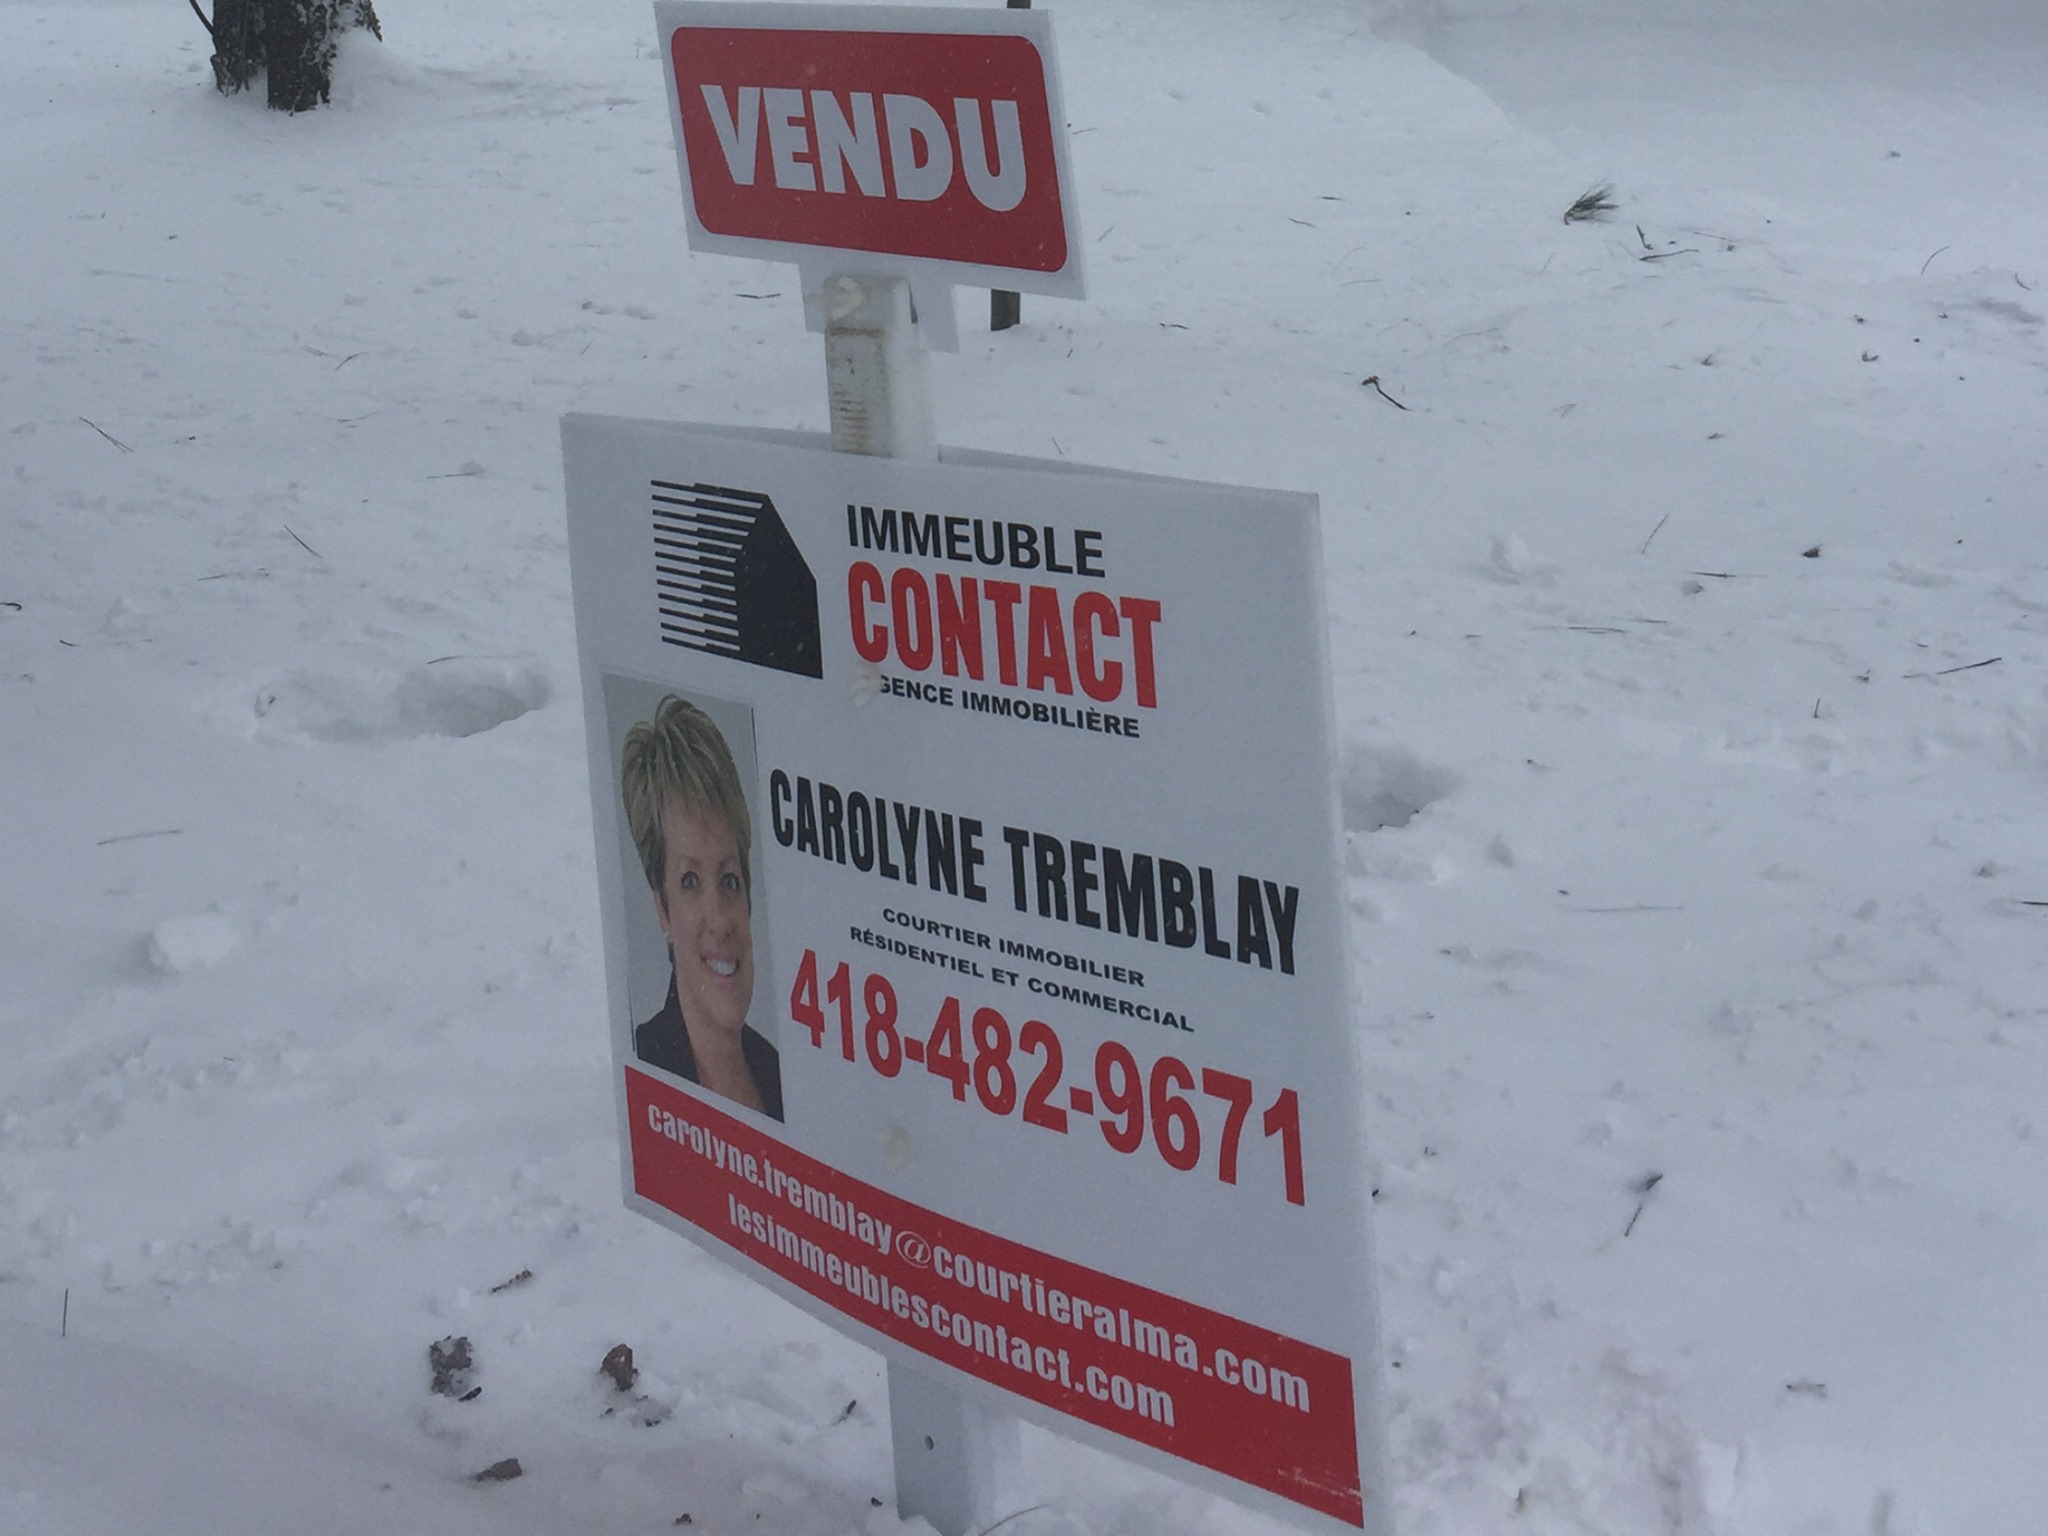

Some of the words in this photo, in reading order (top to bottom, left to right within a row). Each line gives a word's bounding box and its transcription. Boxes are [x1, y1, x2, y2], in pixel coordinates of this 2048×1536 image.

[700, 84, 1027, 212] VENDU
[847, 504, 1106, 578] IMMEUBLE
[848, 560, 1162, 709] CONTACT
[880, 674, 954, 706] GENCE
[962, 690, 1141, 739] IMMOBILIÈRE
[770, 768, 988, 903] CAROLYNE
[1003, 826, 1300, 976] TREMBLAY
[850, 925, 985, 979] RÉSIDENTIEL
[991, 967, 1020, 987] ET
[1028, 977, 1195, 1033] COMMERCIAL
[883, 908, 992, 950] COURTIER
[999, 938, 1146, 987] IMMOBILIER
[790, 948, 1306, 1207] 418-482-9671
[647, 1103, 1310, 1413] carolyne.tremblay@courtieralma.com
[727, 1192, 1175, 1428] lesimmeublescontact.com
